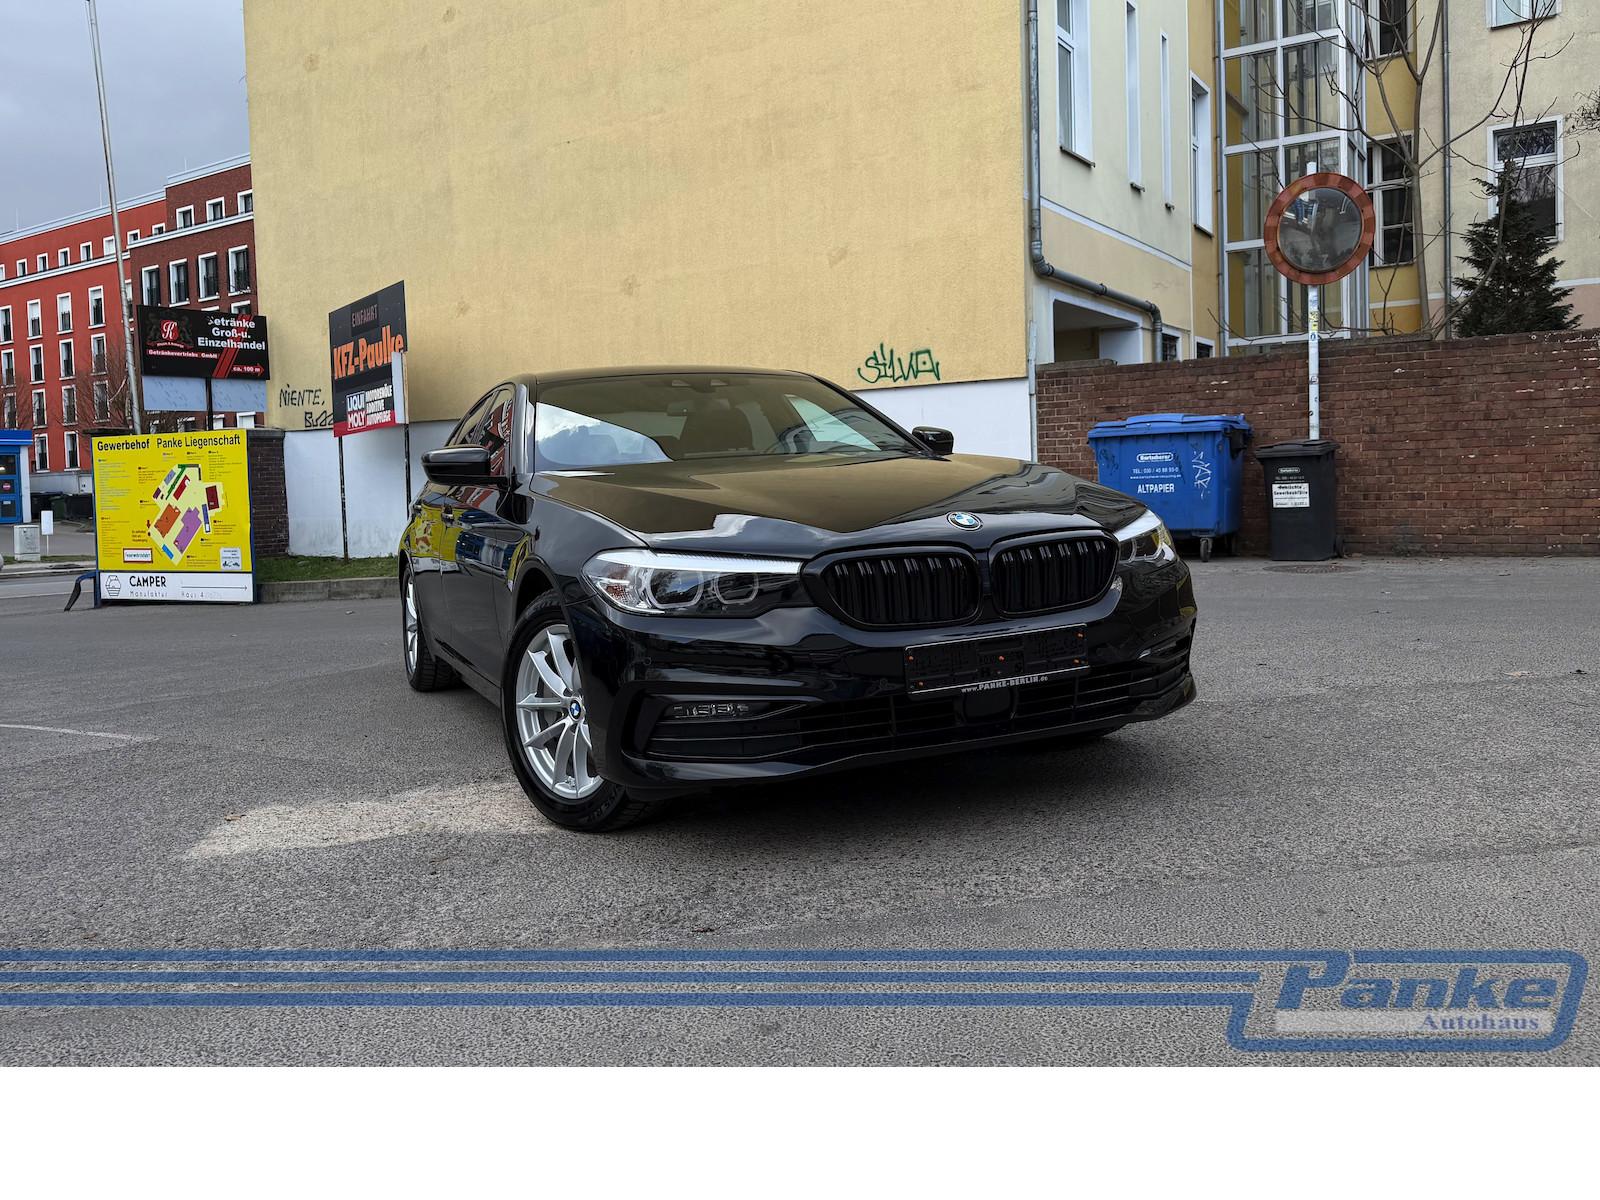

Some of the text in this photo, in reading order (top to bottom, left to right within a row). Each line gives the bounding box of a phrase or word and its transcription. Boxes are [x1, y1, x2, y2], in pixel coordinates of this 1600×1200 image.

[352, 304, 378, 327] EINFAHRT
[212, 328, 251, 339] Groß-u.
[198, 337, 266, 350] Einzelhandel
[333, 325, 404, 380] KFZ-Paulke
[347, 393, 364, 411] LIQUI
[348, 410, 365, 429] MOLY
[97, 434, 241, 451] Gewerbehof Panke Liegenschaft
[1137, 483, 1175, 494] ALTPAPIER
[129, 575, 167, 587] CAMPER
